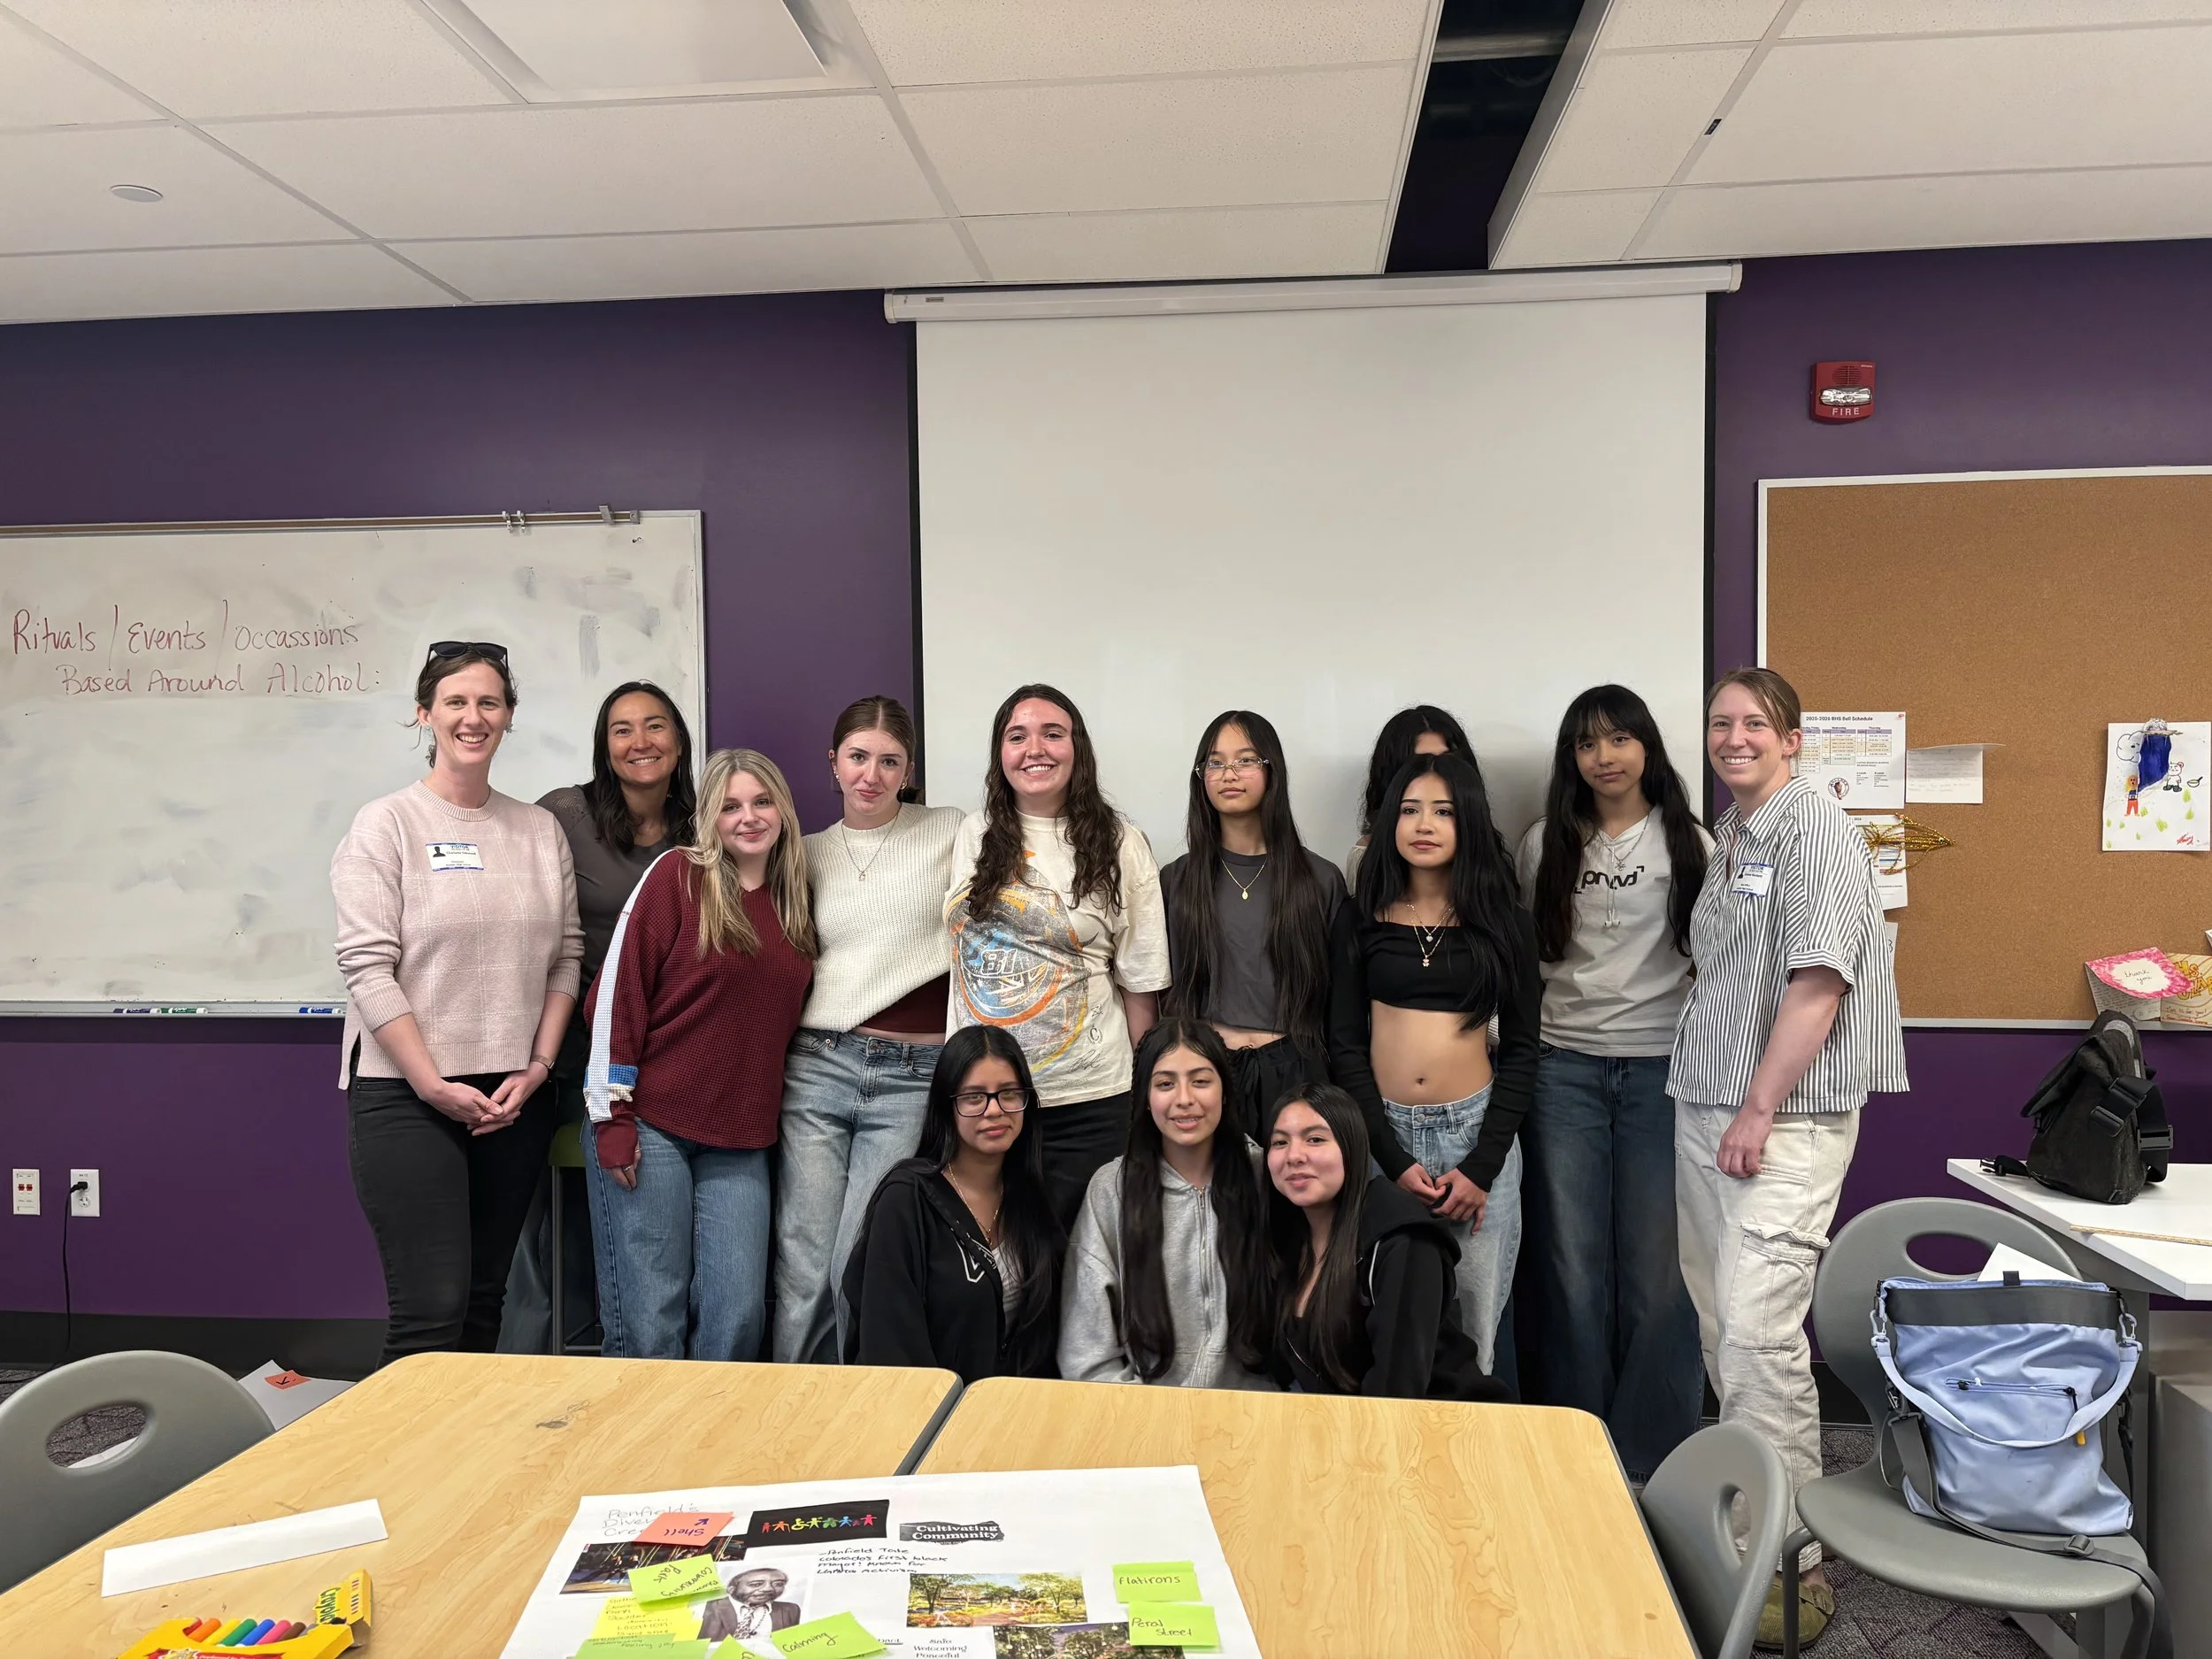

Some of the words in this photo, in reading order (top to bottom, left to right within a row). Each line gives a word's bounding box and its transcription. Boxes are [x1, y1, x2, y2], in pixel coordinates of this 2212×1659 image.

[1832, 407, 1860, 416] FIRE
[13, 609, 96, 654] Rituals
[128, 621, 206, 653] Events
[56, 664, 132, 695] Based
[148, 664, 243, 693] Around
[2137, 976, 2152, 985] you
[315, 1587, 342, 1623] Crayola
[782, 1632, 838, 1653] Calming
[913, 1644, 968, 1653] Welcoming
